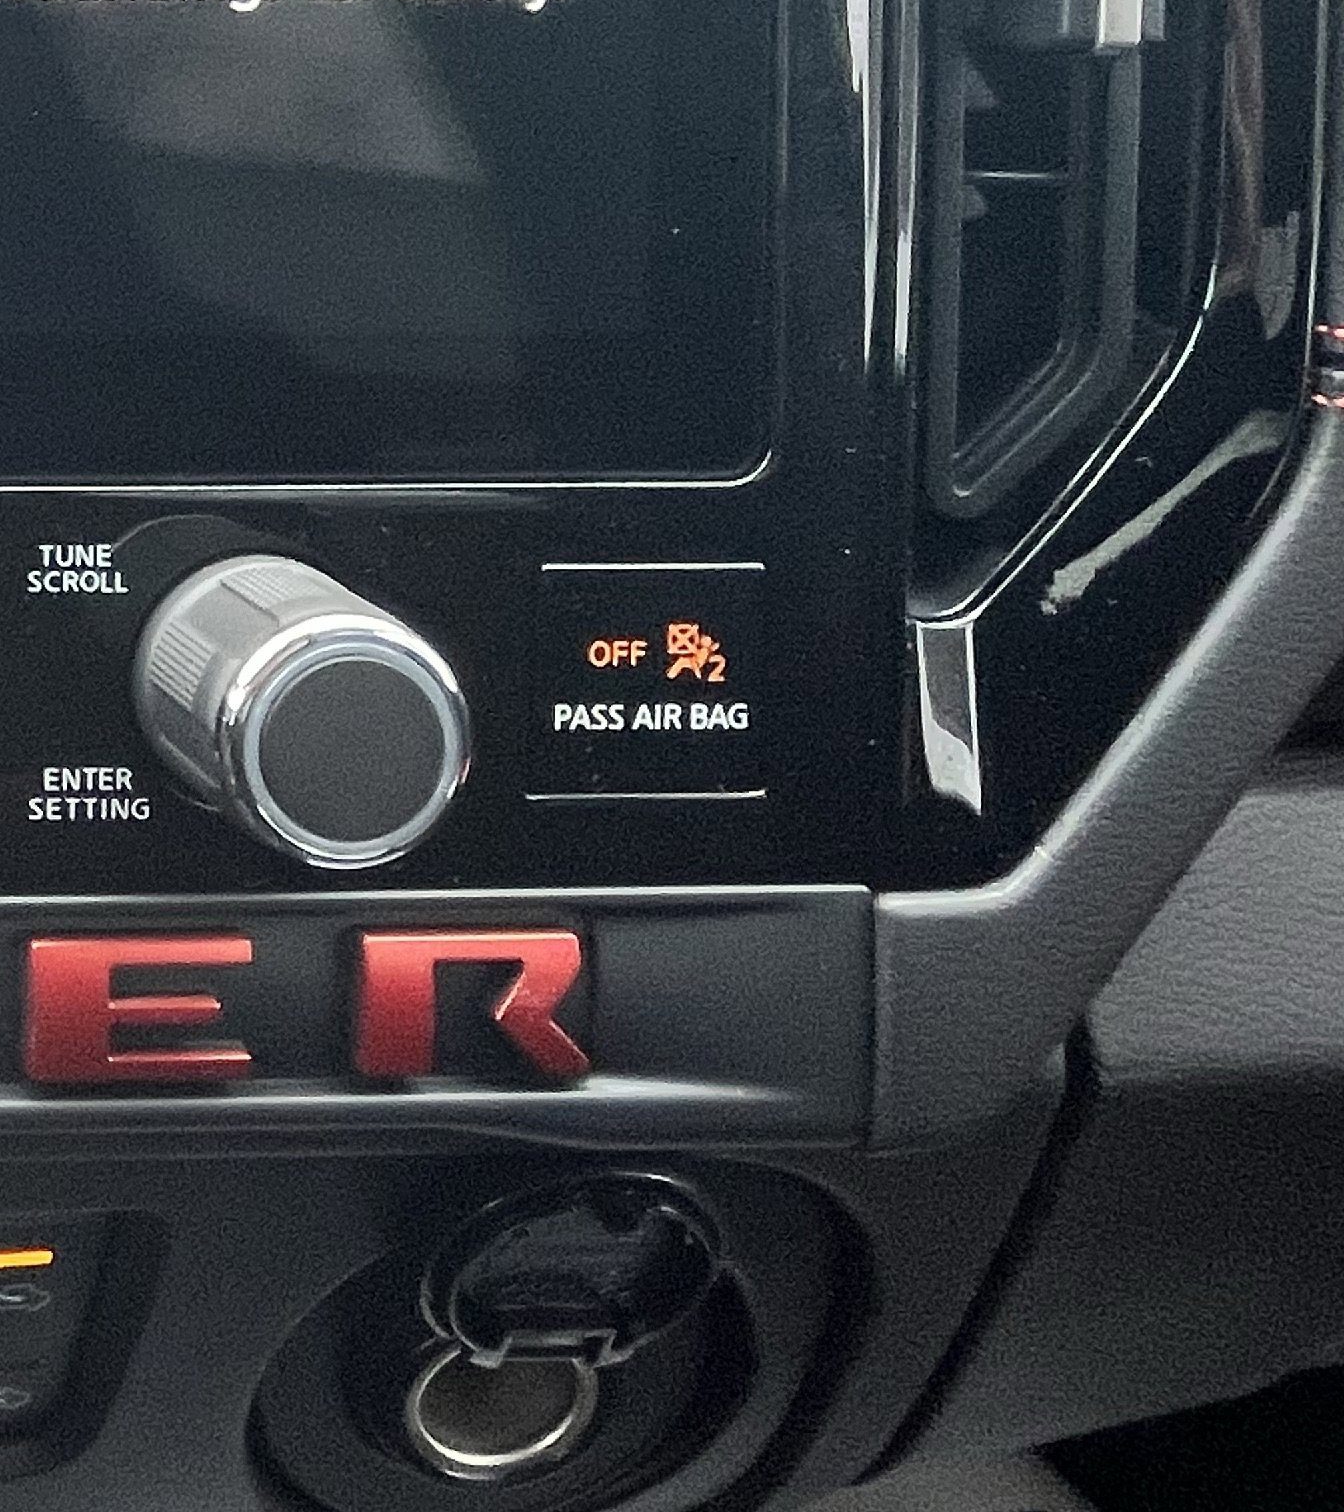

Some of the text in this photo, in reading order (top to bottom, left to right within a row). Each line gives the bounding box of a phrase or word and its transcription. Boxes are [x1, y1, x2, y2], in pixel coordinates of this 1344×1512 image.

[38, 543, 112, 568] TUNE
[27, 570, 129, 594] SCROLL
[588, 640, 648, 668] OFF
[554, 702, 750, 731] PASS AIR BAG
[43, 767, 133, 792] ENTER
[27, 796, 151, 821] SETTING
